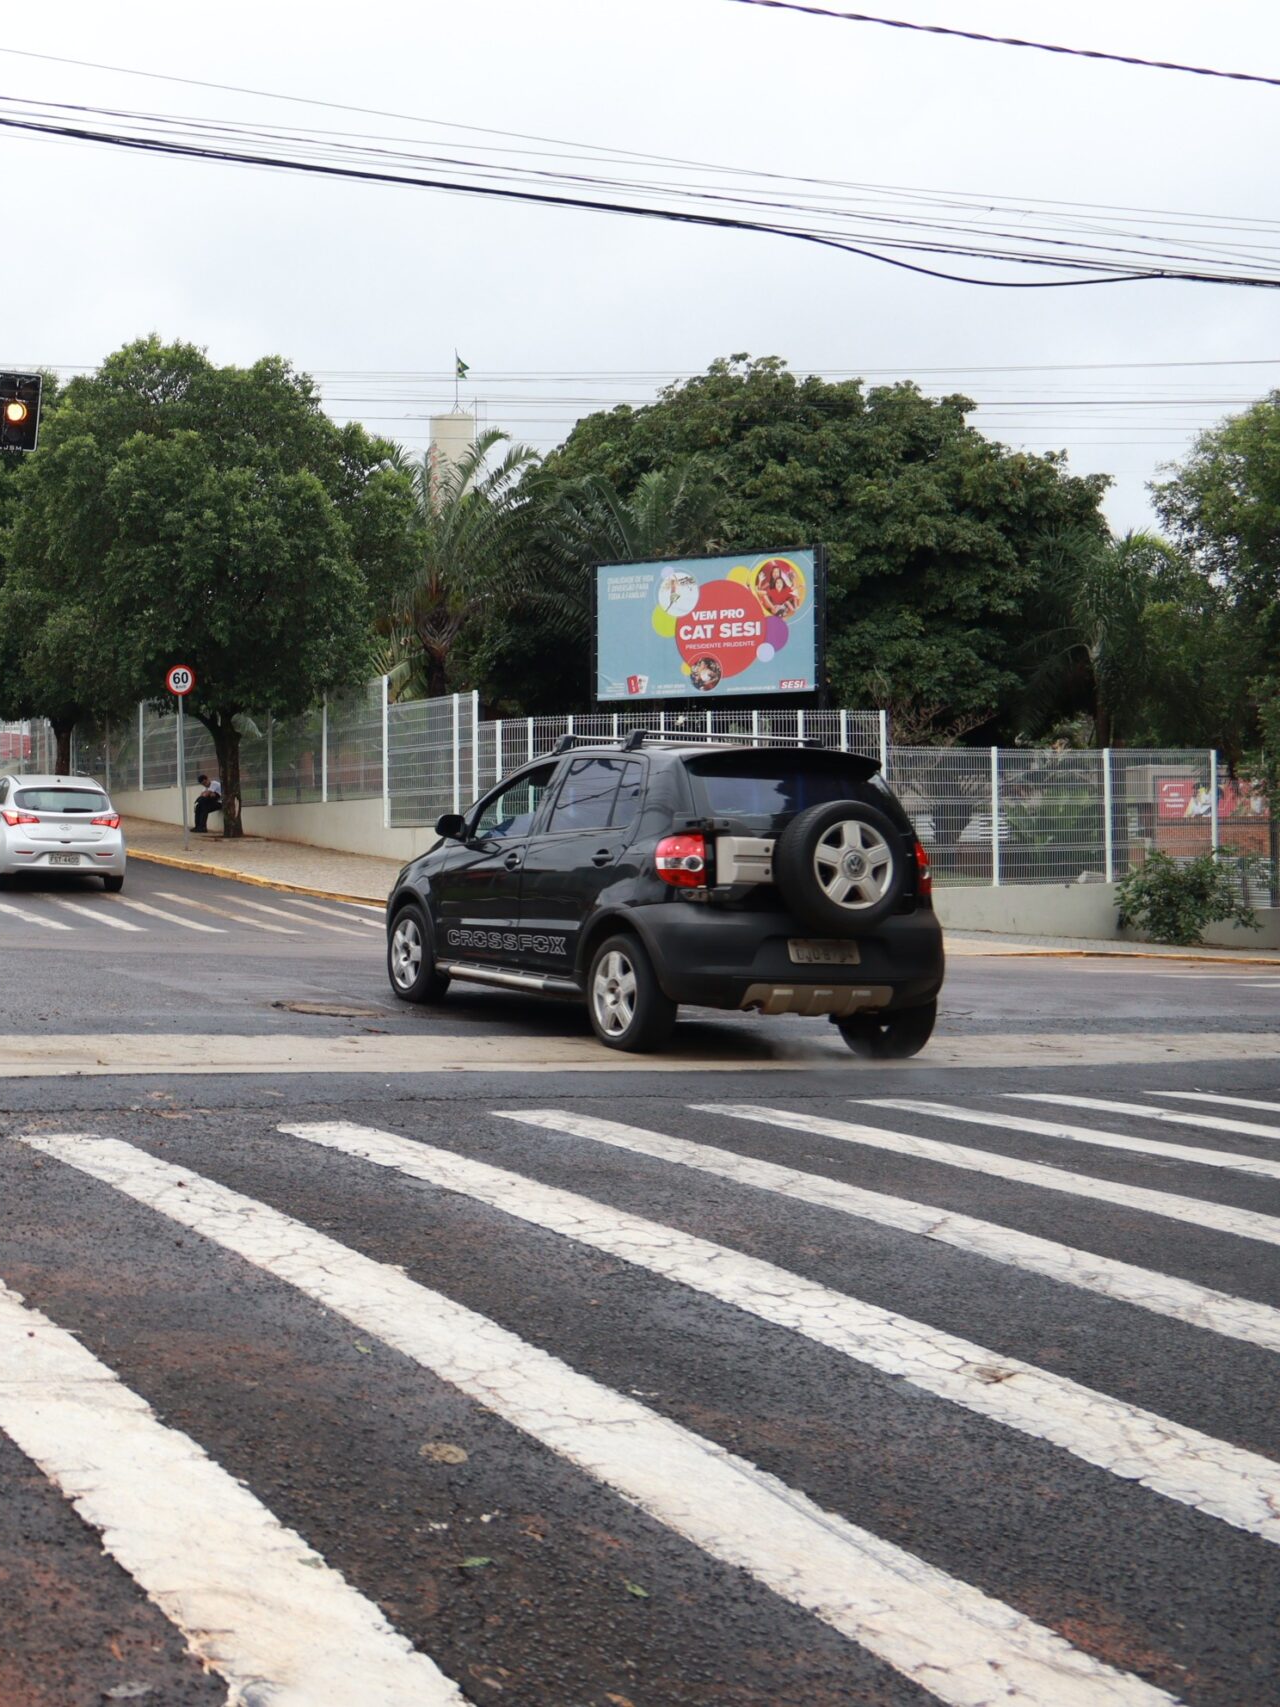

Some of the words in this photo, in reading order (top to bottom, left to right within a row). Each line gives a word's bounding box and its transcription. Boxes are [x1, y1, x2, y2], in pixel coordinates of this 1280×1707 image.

[691, 610, 717, 621] VEM
[720, 608, 745, 619] PRO
[679, 624, 715, 641] CAT
[719, 621, 761, 638] SESI
[685, 642, 721, 650] PRESIDENTE
[723, 640, 755, 648] PRUDENTE
[173, 671, 189, 685] 60
[781, 680, 804, 689] SESI
[447, 929, 567, 956] CROSSFOX
